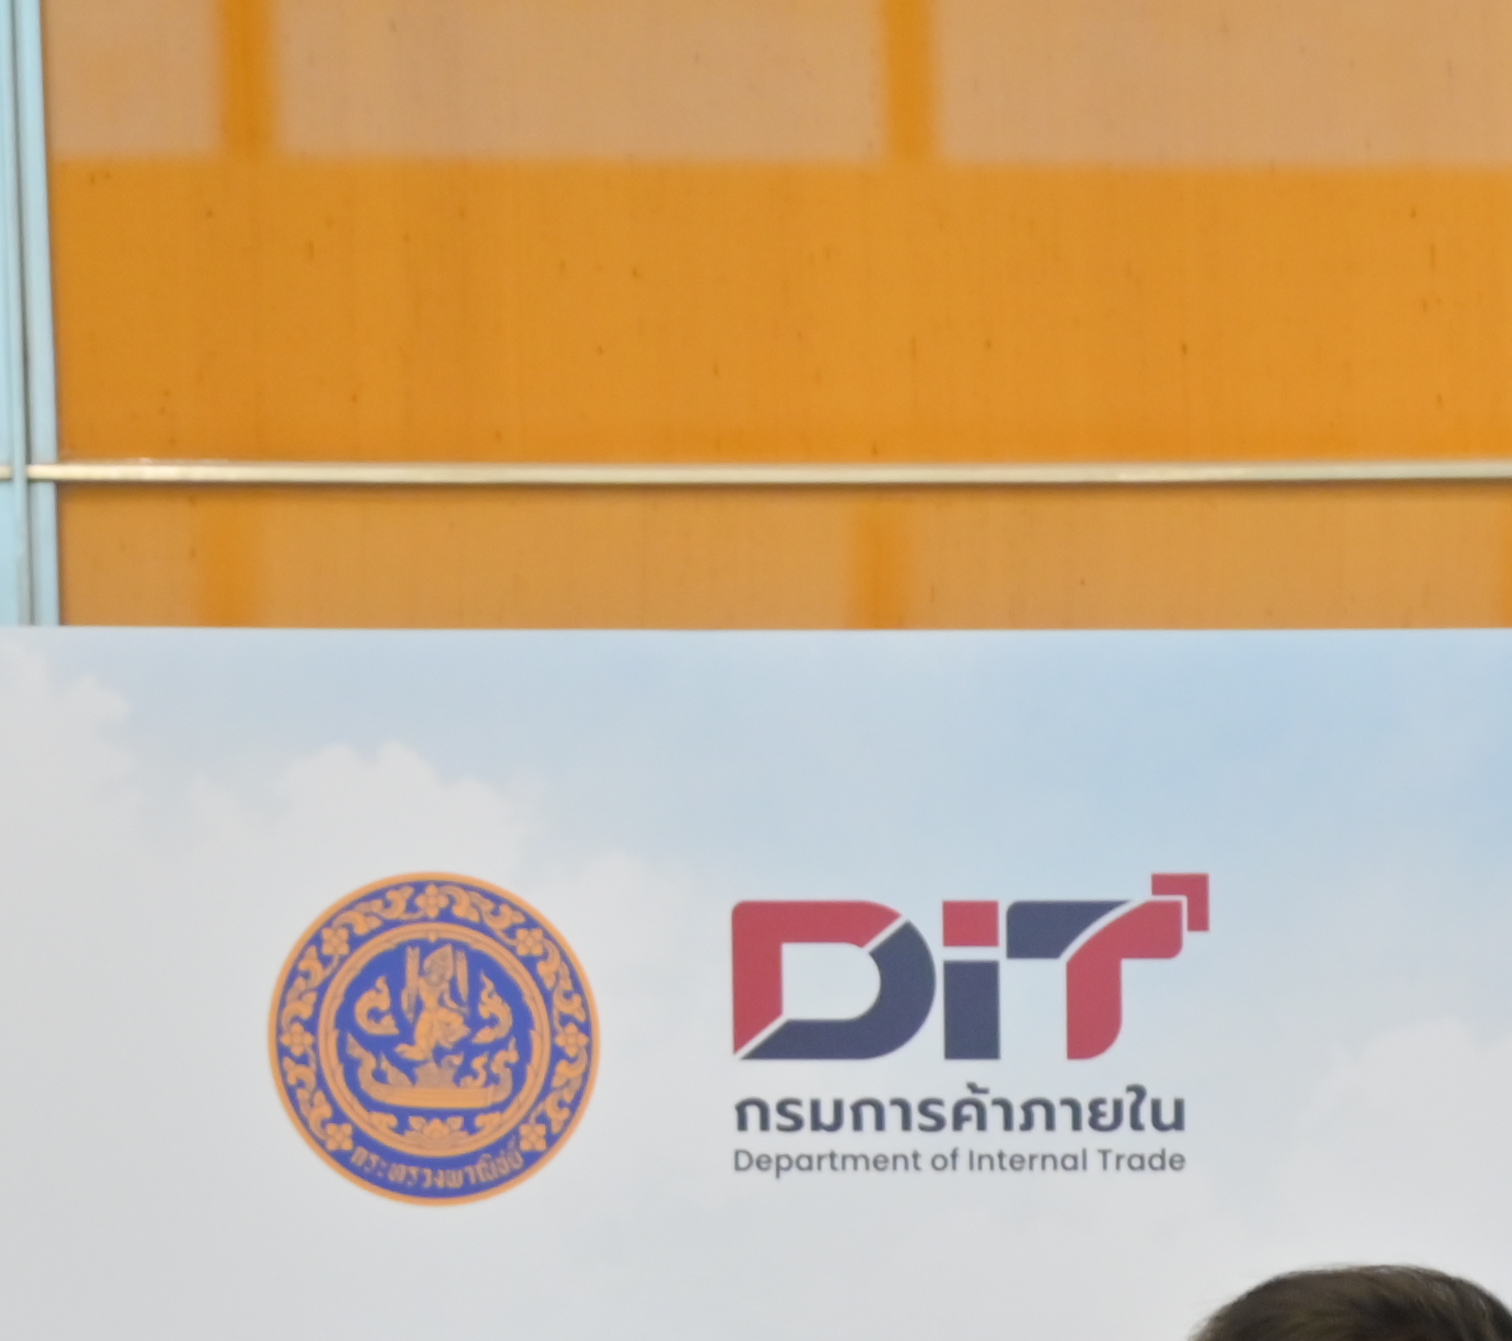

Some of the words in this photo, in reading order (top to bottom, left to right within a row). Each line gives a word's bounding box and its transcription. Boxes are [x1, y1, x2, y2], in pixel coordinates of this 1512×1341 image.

[733, 1081, 1186, 1134] กรมการค้าภายใน
[733, 1149, 922, 1179] Department
[930, 1147, 960, 1172] of
[968, 1147, 1088, 1172] Internal
[1096, 1147, 1187, 1172] Trade
